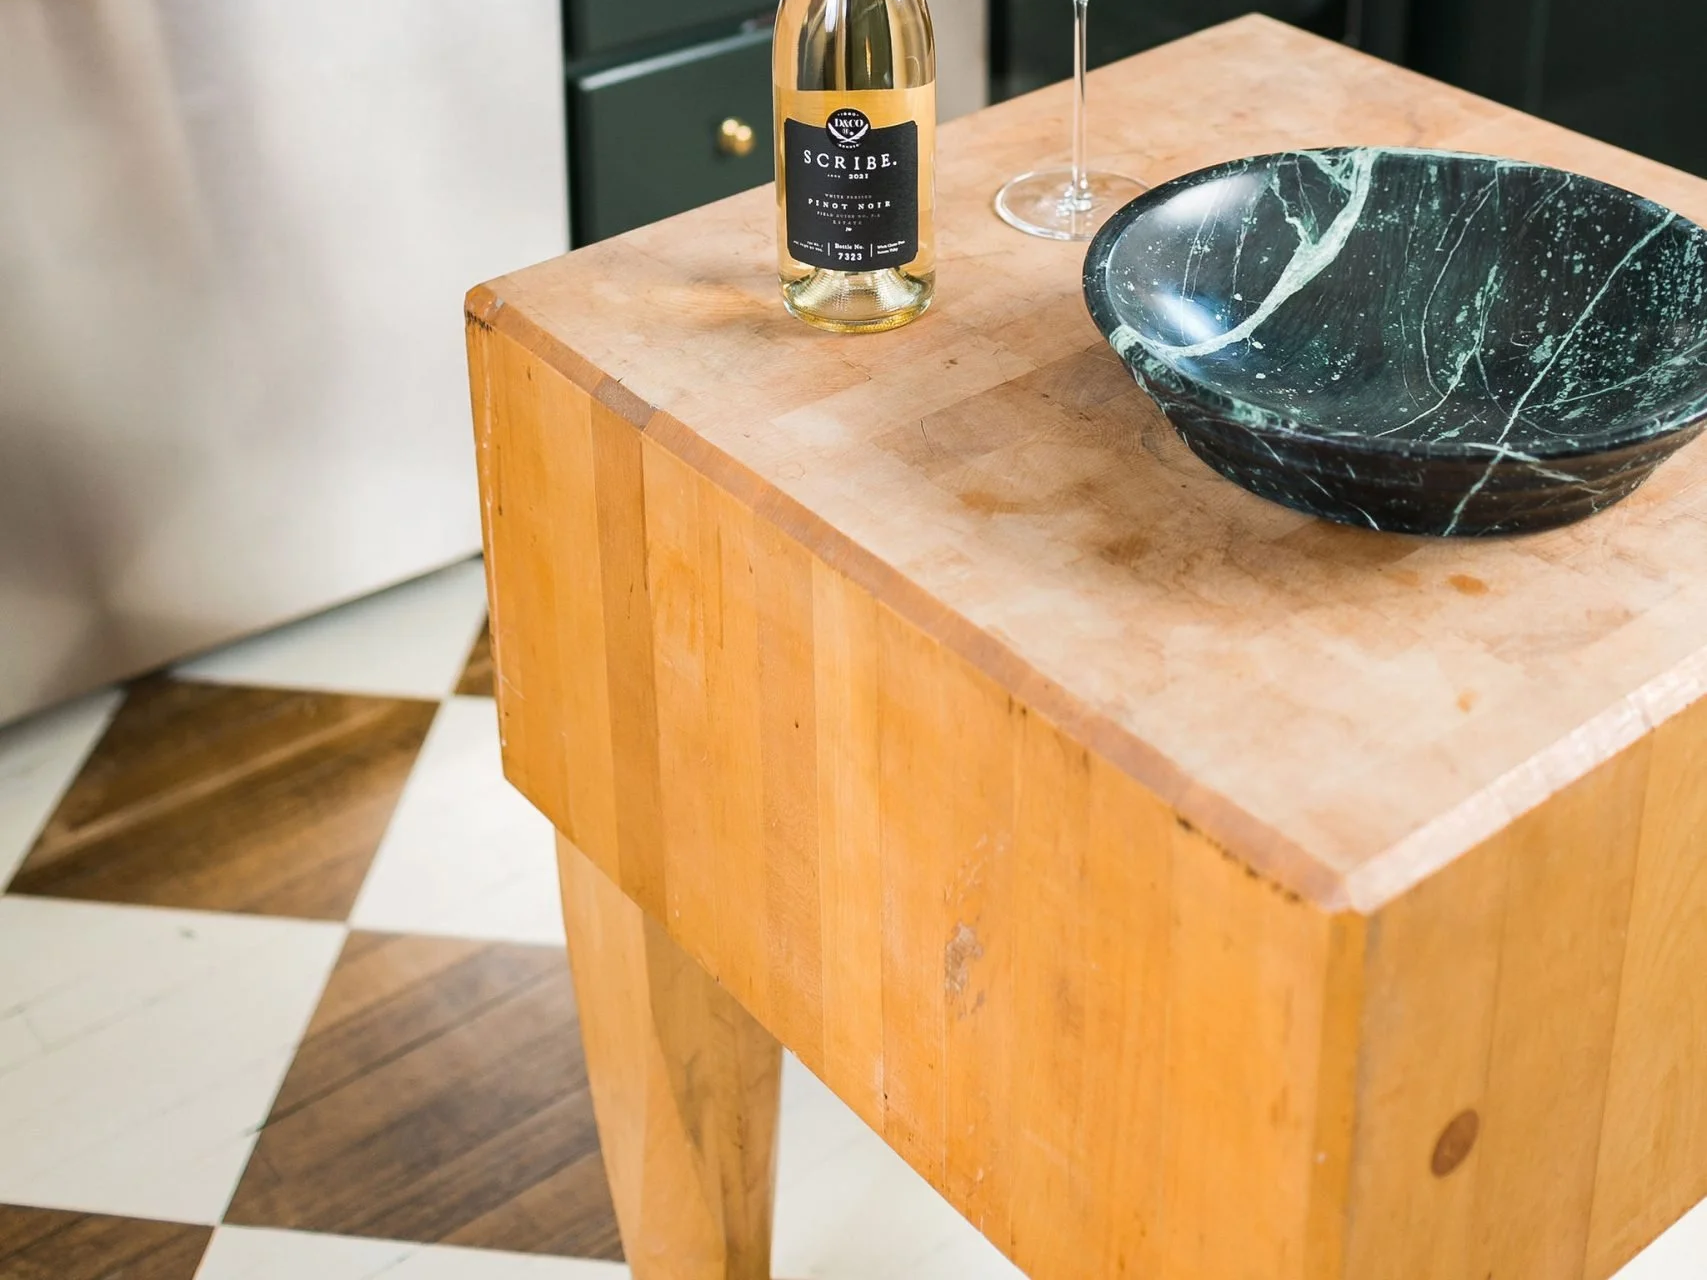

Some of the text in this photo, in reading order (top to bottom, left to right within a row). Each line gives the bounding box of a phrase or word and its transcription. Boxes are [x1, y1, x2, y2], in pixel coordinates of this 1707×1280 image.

[803, 149, 898, 171] SCRIBE.
[807, 198, 891, 210] PINOT NOIR
[834, 242, 853, 250] Bottle
[837, 252, 863, 261] 7323
